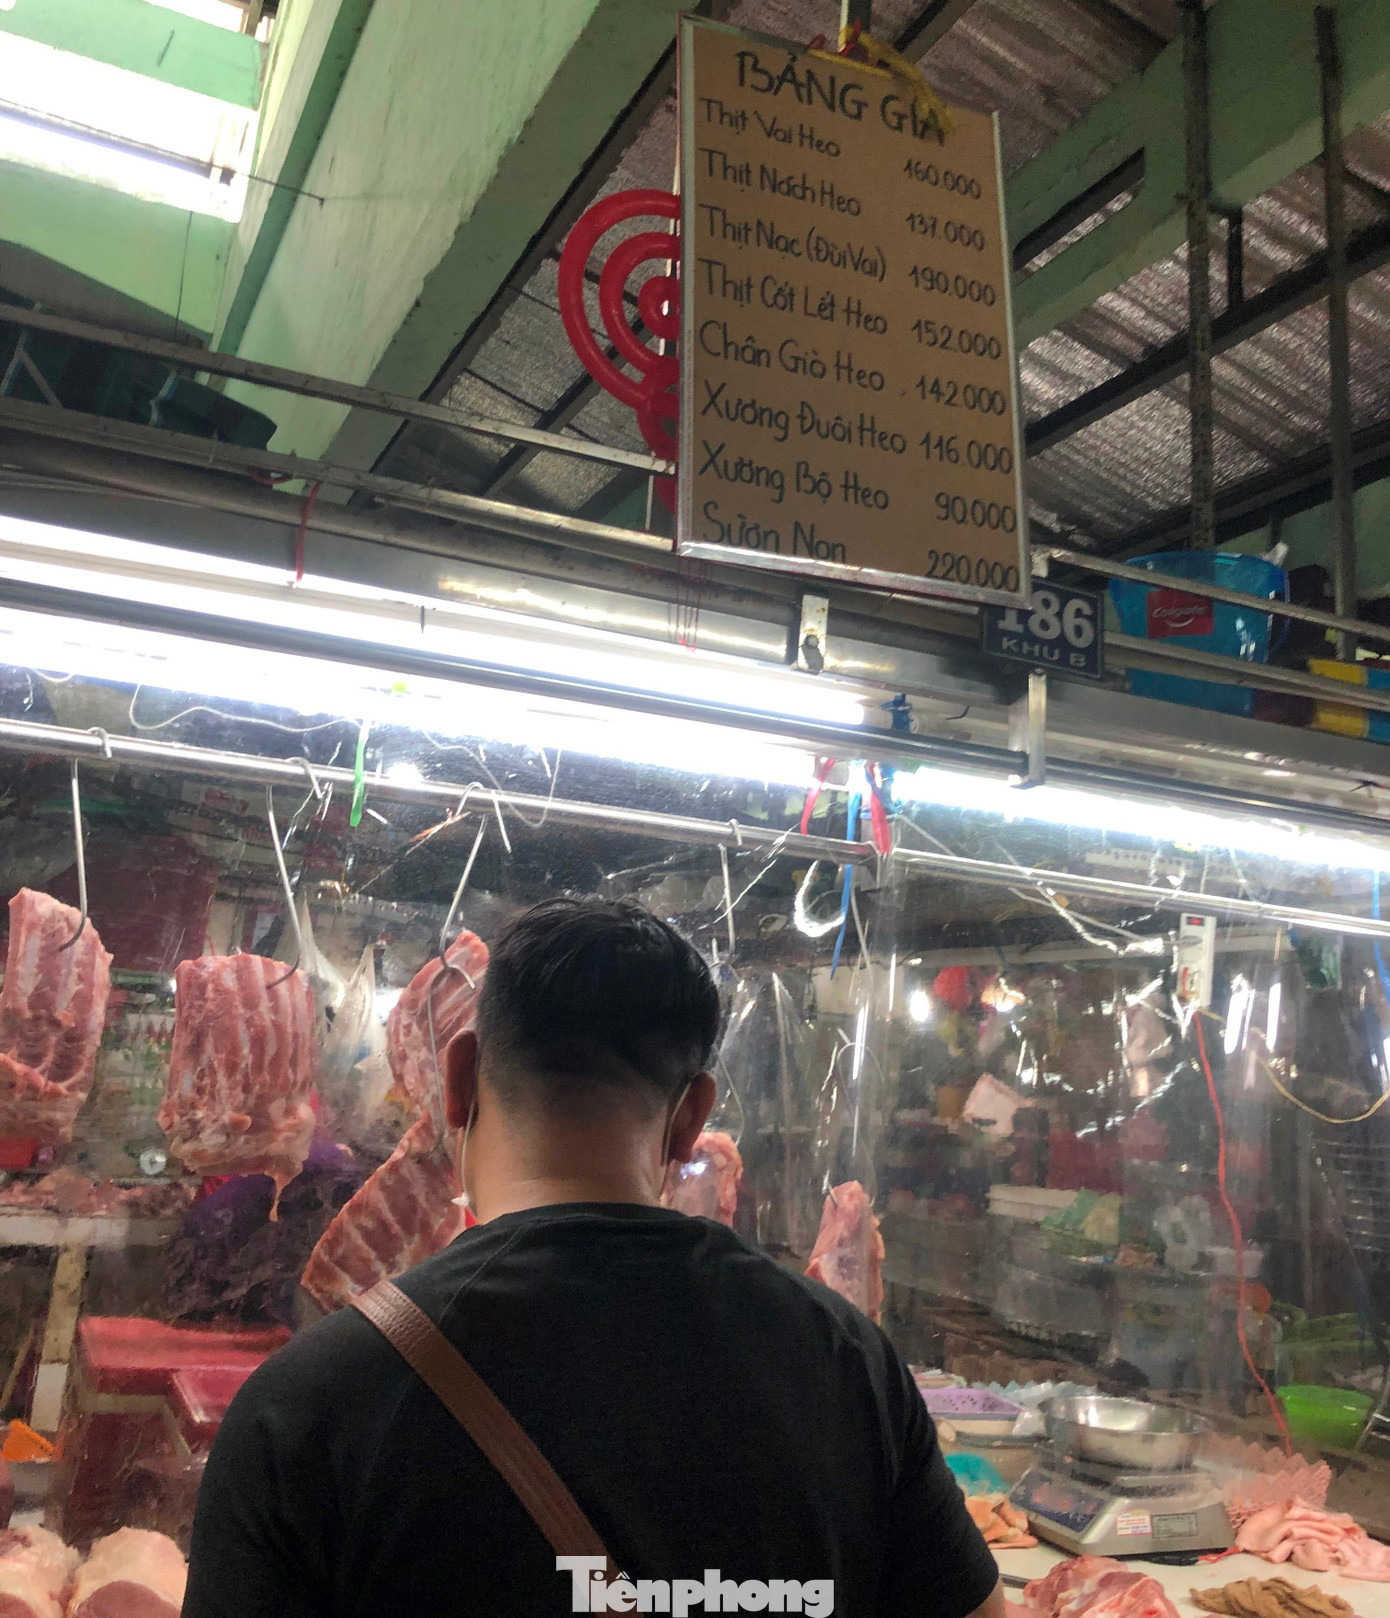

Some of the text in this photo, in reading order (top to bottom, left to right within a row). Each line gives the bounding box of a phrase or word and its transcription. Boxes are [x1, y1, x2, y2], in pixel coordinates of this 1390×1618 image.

[735, 52, 869, 121] BẢNG
[699, 97, 983, 200] Thịt Vai Heo 160.000
[698, 147, 985, 252] Thịt Nách Heo 137.000
[698, 203, 752, 250] Thịt
[755, 218, 803, 259] Nạc
[909, 265, 996, 307] 190.000
[697, 258, 1002, 360] Thịt Cốt Lết Heo 152.000
[699, 319, 1006, 416] Chân Giò Heo 142.000
[700, 379, 1013, 474] Xương Đuôi Heo 116.000
[703, 500, 1020, 592] Sườn Non 220.000
[796, 461, 832, 503] Bộ
[840, 470, 890, 510] Heo
[935, 492, 1017, 535] 90.000
[1002, 637, 1087, 667] KHU B
